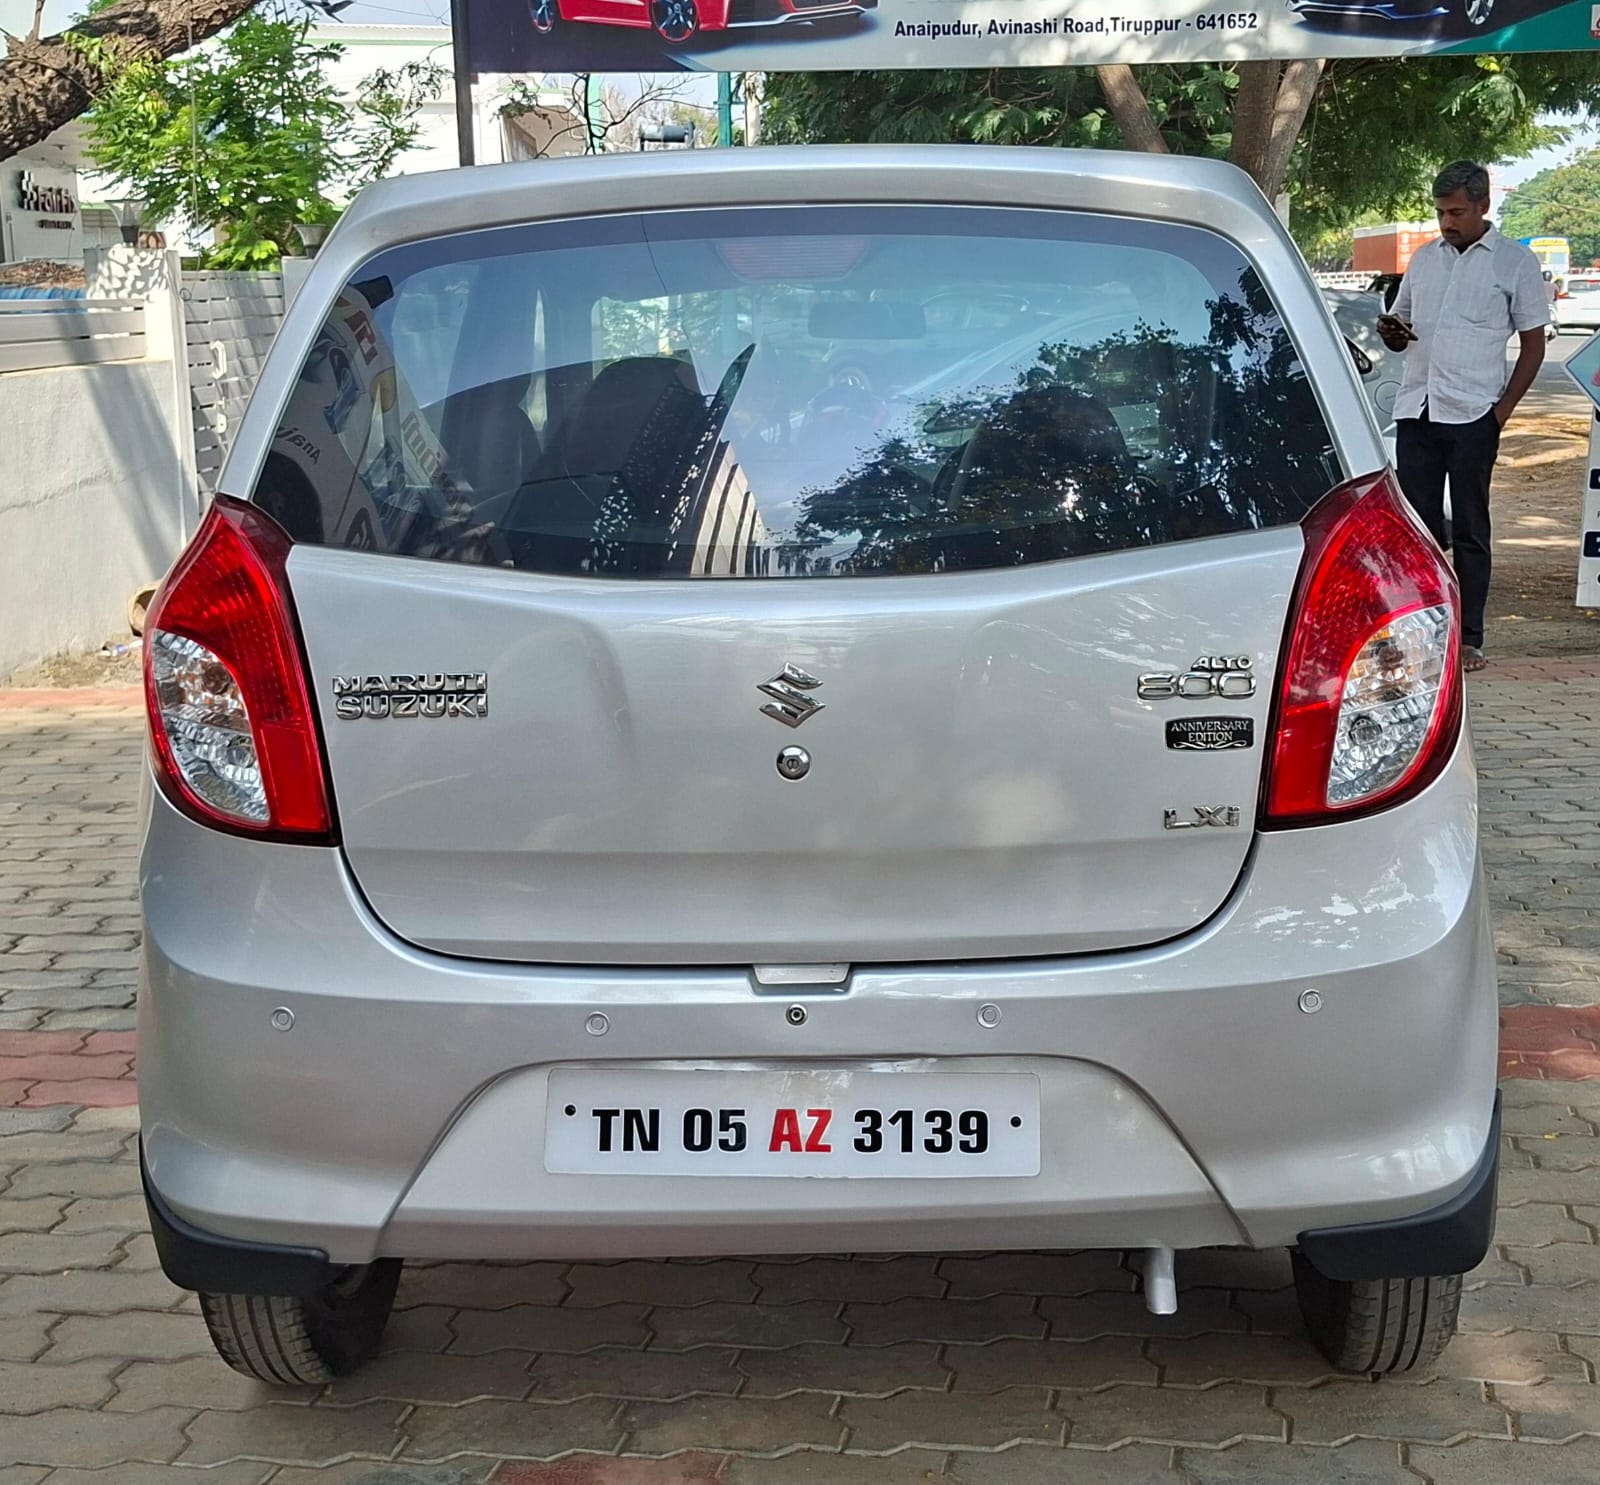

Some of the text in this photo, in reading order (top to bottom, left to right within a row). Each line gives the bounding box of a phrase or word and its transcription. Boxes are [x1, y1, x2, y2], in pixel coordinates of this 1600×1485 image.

[894, 20, 982, 40] Anaipudur,
[987, 18, 1058, 35] Avinashi
[1196, 13, 1257, 30] 641652
[1191, 655, 1253, 671] ALTO
[332, 673, 488, 695] MARUTI
[1137, 671, 1257, 700] 800
[335, 694, 489, 720] SUZUKI
[1171, 720, 1250, 732] ANNIVERSARY
[1188, 731, 1233, 742] EDITION
[1164, 805, 1240, 829] LXi
[592, 1108, 989, 1154] TN 05 AZ 3139
